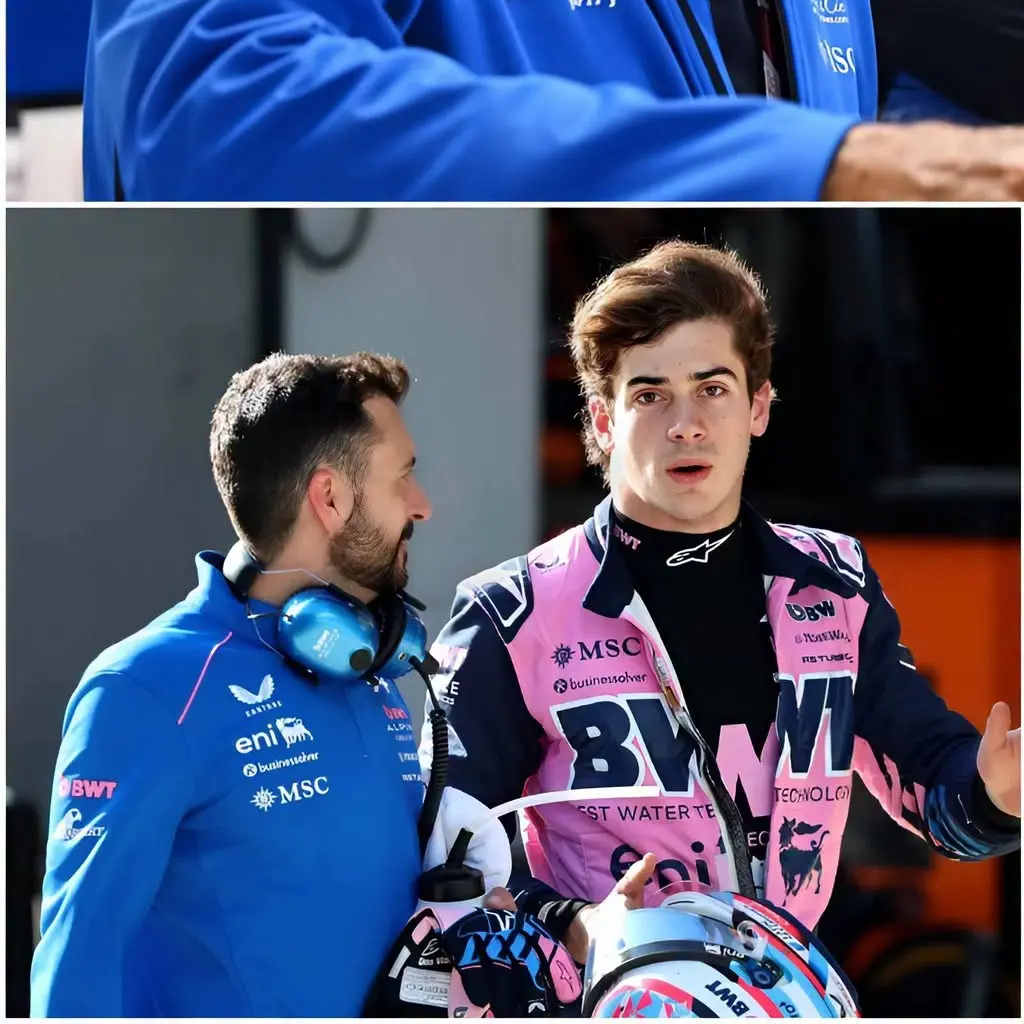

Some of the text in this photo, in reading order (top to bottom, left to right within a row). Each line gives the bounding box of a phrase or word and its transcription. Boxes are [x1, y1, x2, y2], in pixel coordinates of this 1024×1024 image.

[577, 637, 641, 661] MSC
[235, 723, 279, 754] eni
[71, 779, 118, 799] BWT
[277, 776, 330, 805] MSC
[616, 805, 690, 822] WATER
[704, 979, 751, 1018] BWT
